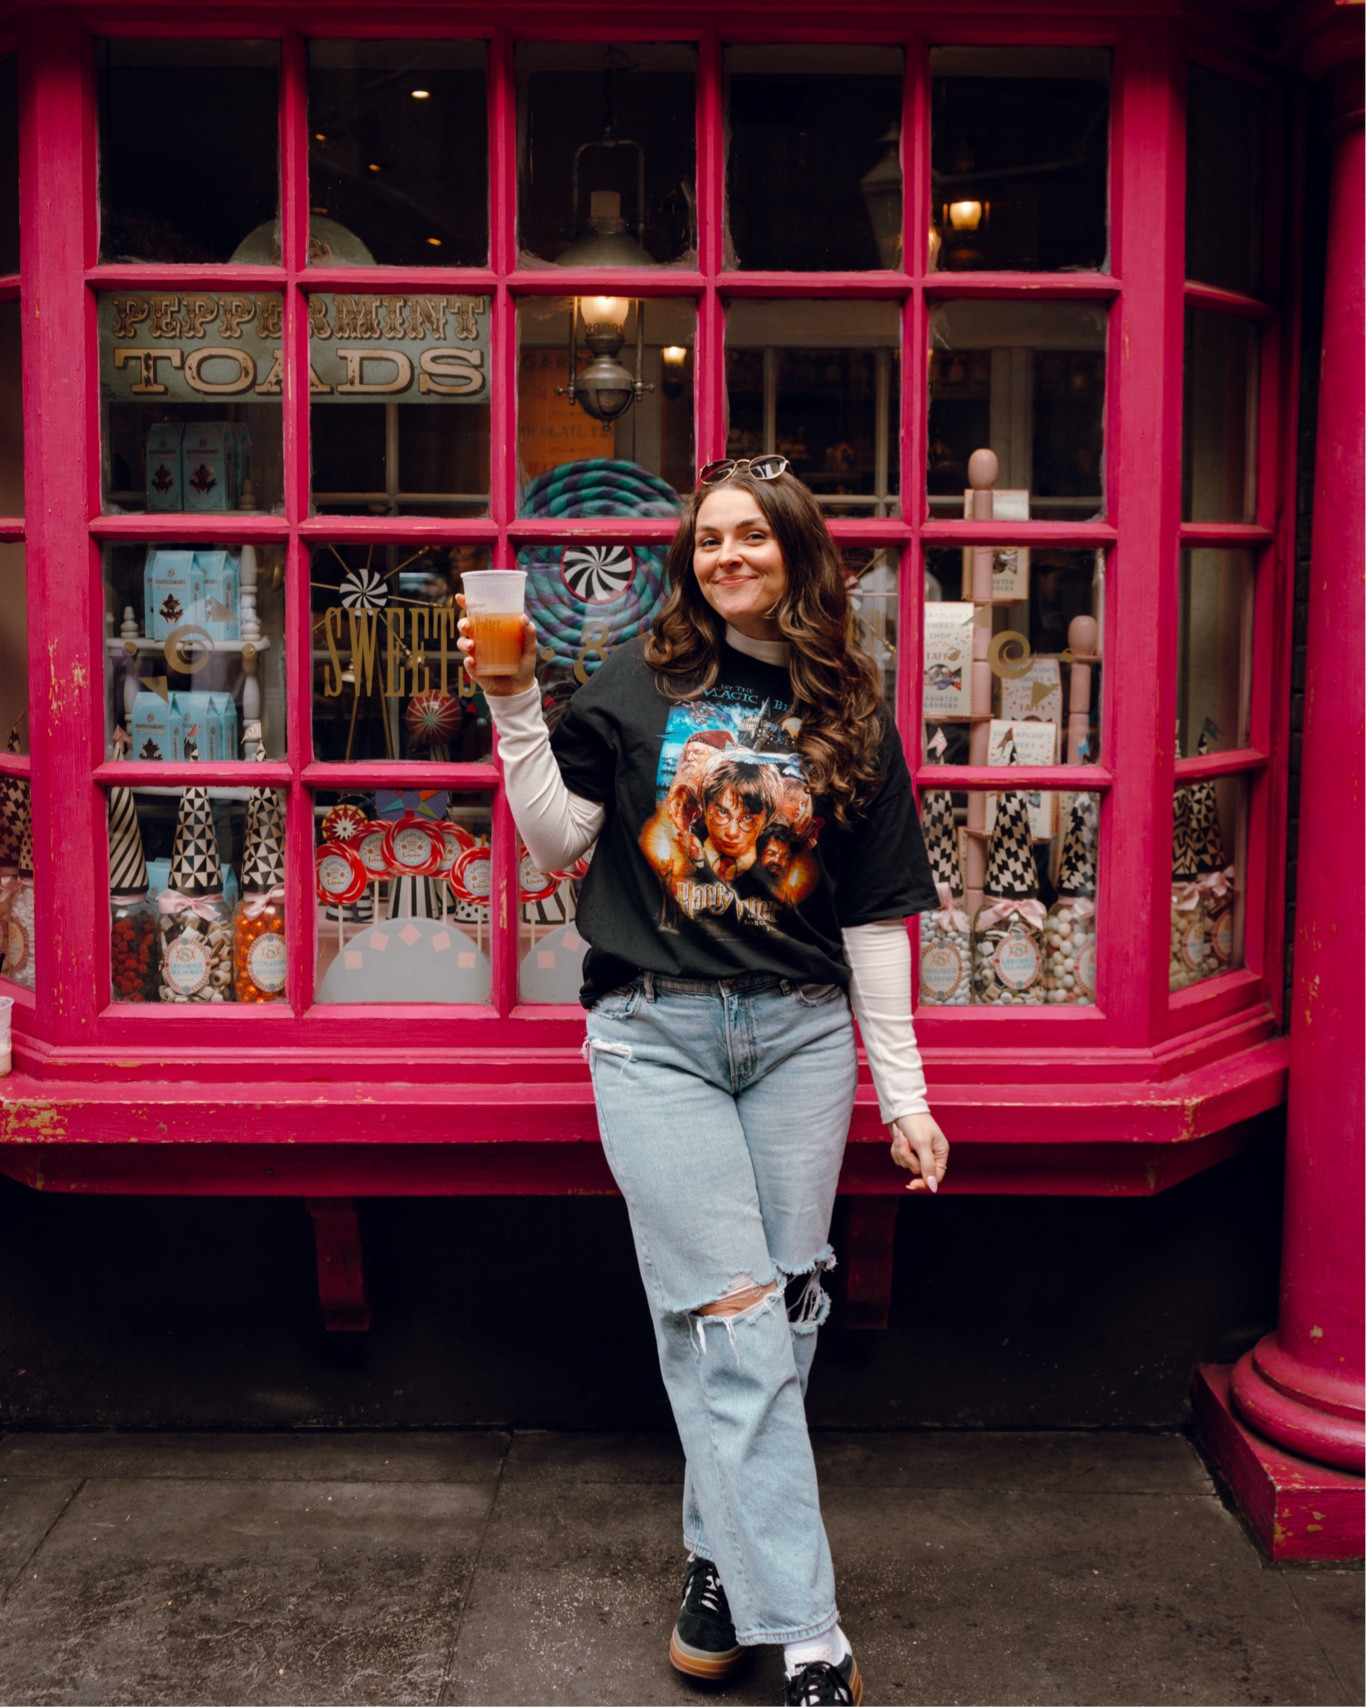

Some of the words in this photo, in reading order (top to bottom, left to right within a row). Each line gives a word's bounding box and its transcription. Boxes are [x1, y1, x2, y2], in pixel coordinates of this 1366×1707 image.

[112, 294, 484, 340] PEPPERMINT
[114, 347, 486, 395] TOADS
[736, 685, 754, 695] THE
[1020, 703, 1046, 712] TAFY
[677, 881, 734, 920] Harry
